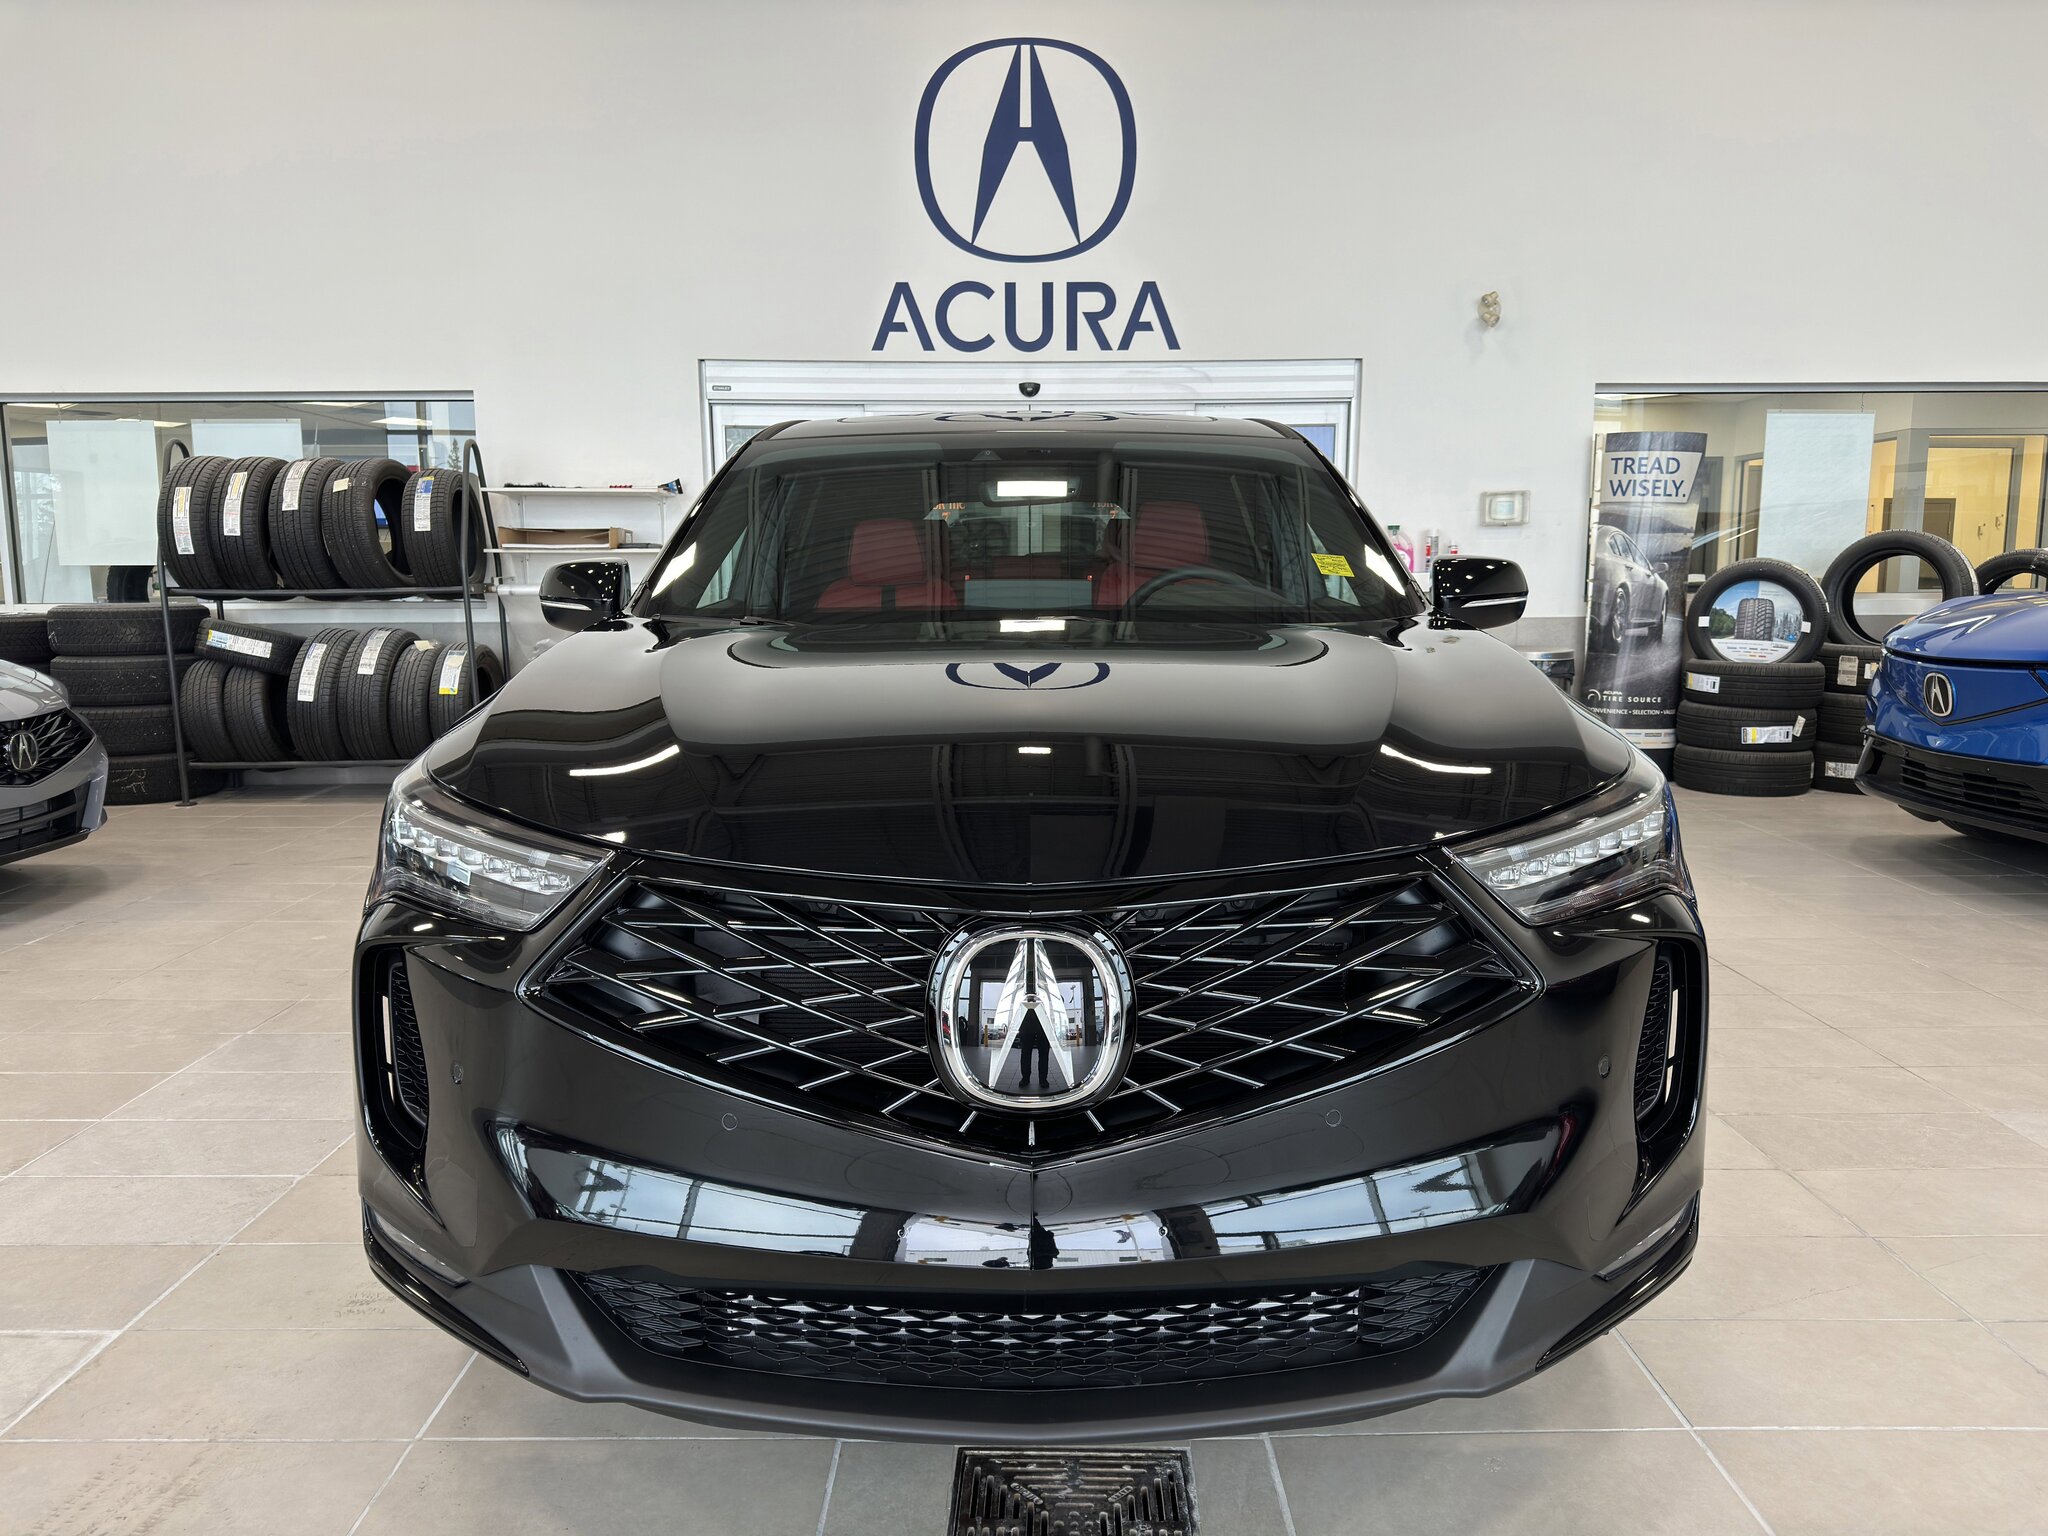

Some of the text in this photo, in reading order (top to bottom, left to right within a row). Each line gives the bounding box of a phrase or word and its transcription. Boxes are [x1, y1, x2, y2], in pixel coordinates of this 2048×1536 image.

[871, 280, 1181, 352] ACURA
[1611, 457, 1681, 475] TREAD
[1609, 479, 1686, 498] WISELY.
[1602, 695, 1623, 703] TIRE
[1589, 707, 1628, 715] ONVENIENCE
